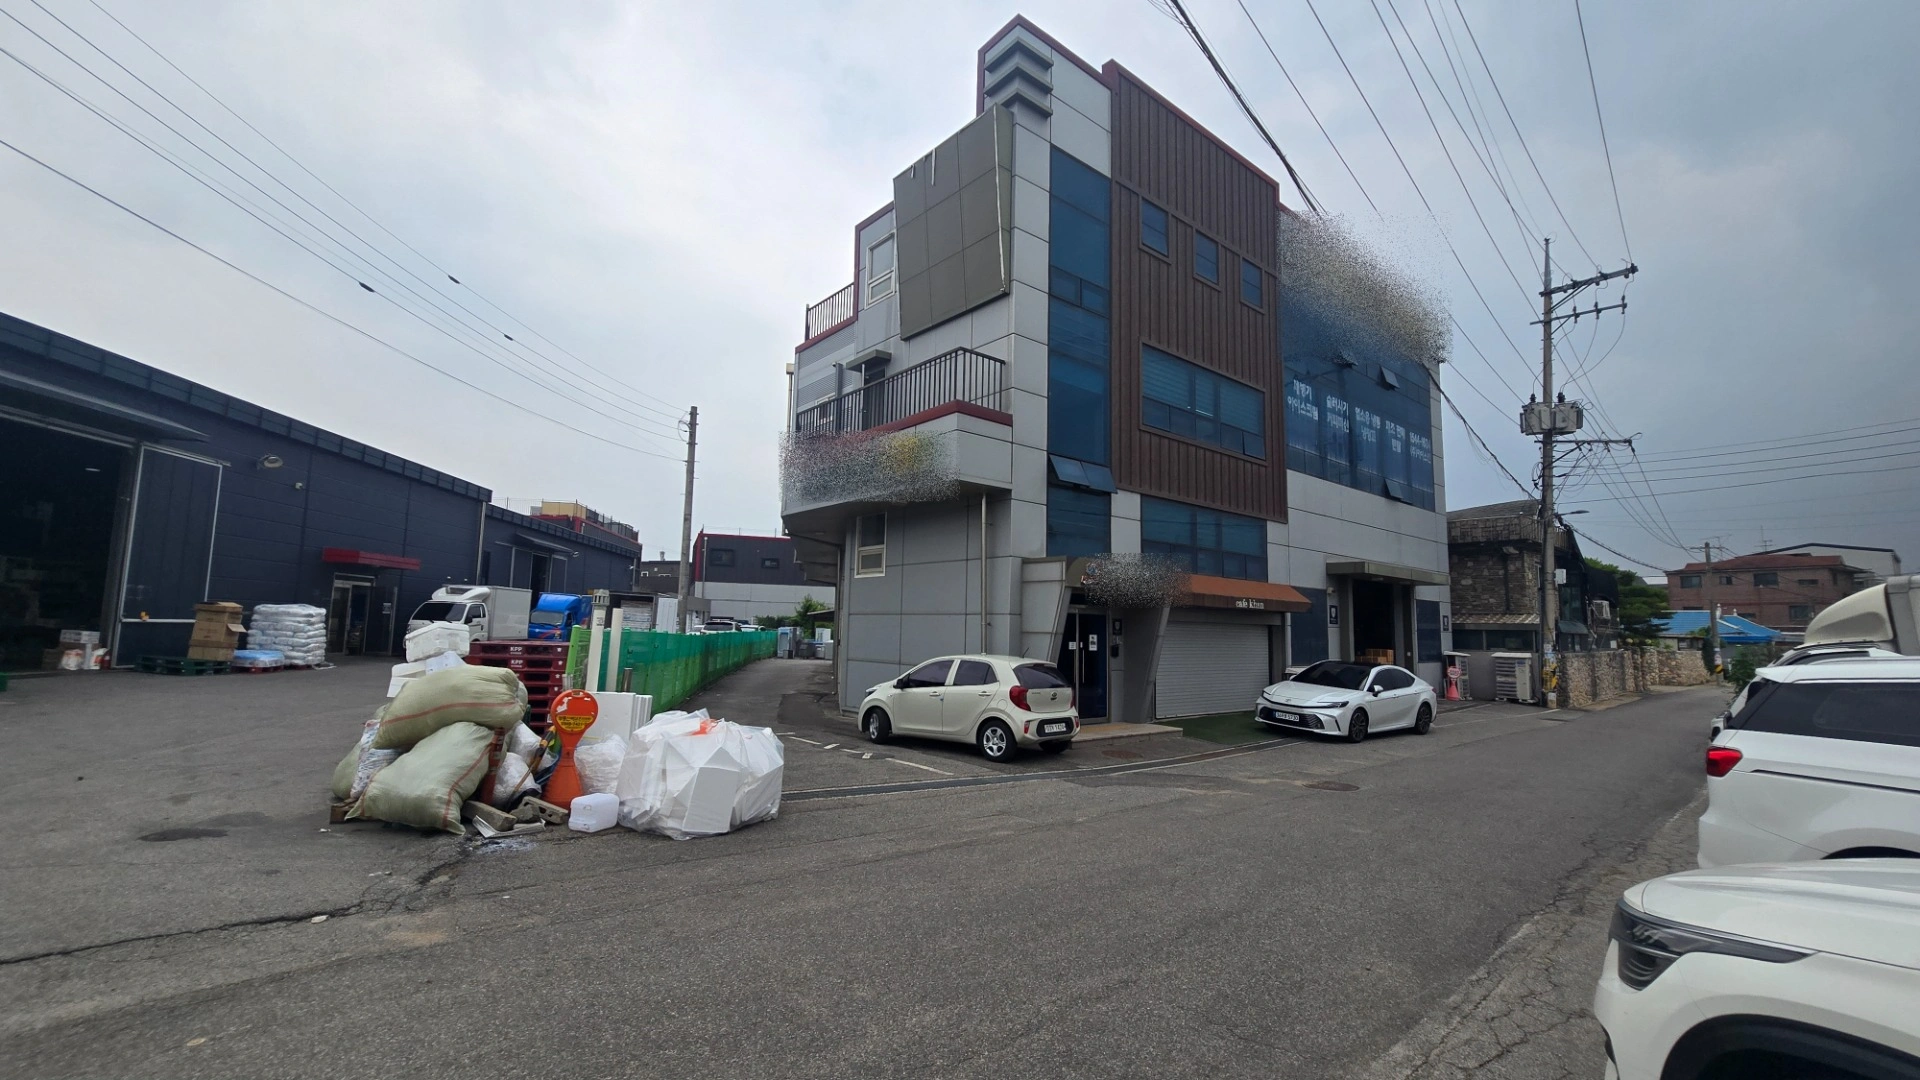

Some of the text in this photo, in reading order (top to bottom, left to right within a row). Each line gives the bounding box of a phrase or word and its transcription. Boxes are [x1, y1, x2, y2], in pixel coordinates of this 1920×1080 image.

[1293, 379, 1312, 401] 제빙기
[1287, 396, 1319, 422] 아이스크림
[1326, 395, 1349, 416] 슬러시기
[1235, 598, 1248, 608] cafe
